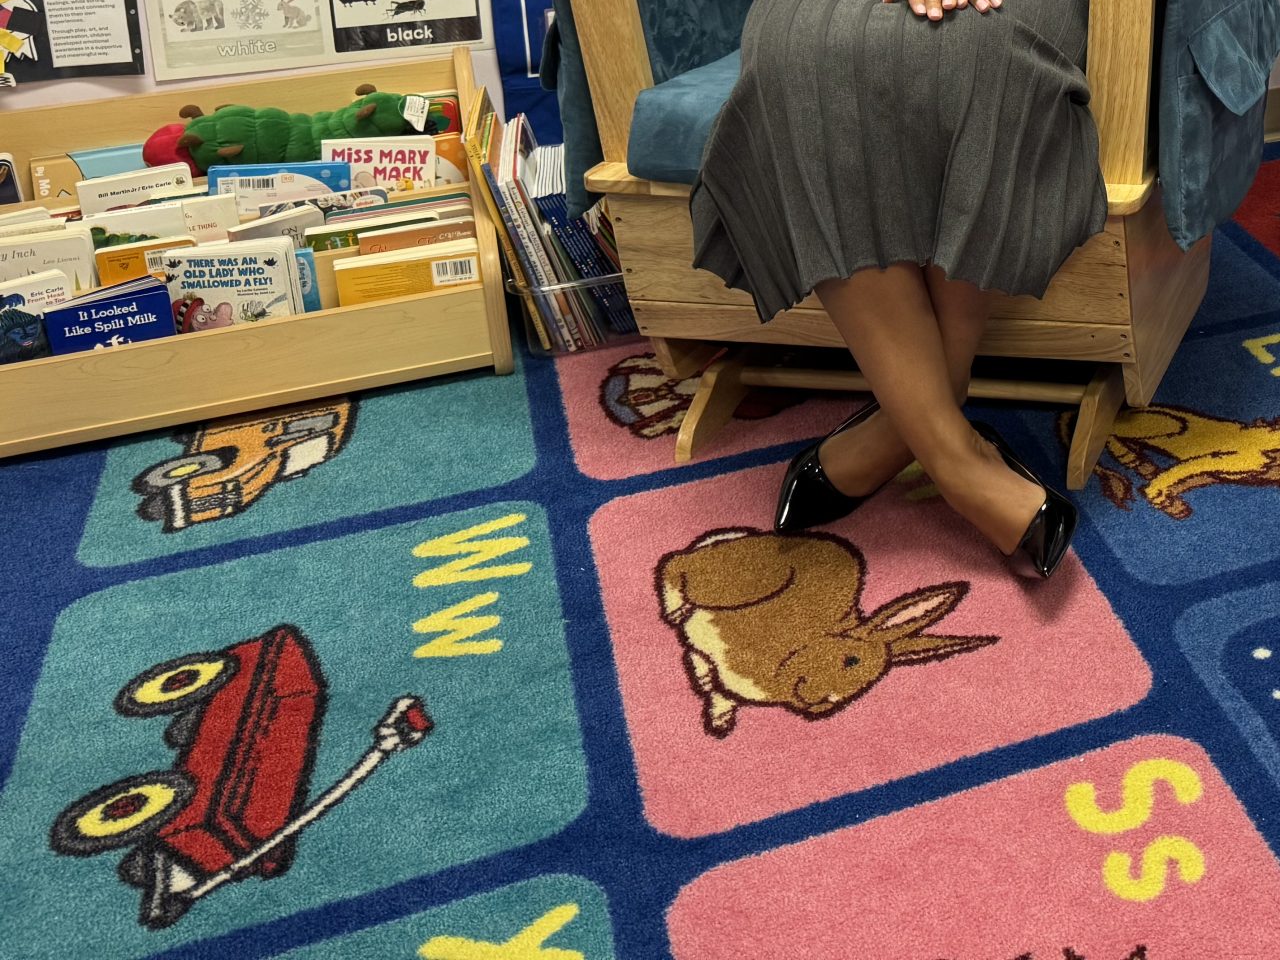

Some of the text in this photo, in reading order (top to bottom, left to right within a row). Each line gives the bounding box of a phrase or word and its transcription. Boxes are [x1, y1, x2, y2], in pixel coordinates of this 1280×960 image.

[386, 24, 434, 42] black
[218, 38, 277, 57] white
[379, 149, 430, 165] MARY
[373, 166, 424, 181] MACK
[12, 248, 37, 260] Inch
[186, 257, 258, 269] THERE WAS AN
[183, 267, 265, 279] OLD LADY WHO
[180, 276, 273, 290] SWALLOWED A FLY!
[27, 292, 65, 304] From Head
[30, 286, 64, 298] Eric Carle
[78, 302, 138, 321] It Looked
[64, 313, 157, 338] Like Spilt Milk
